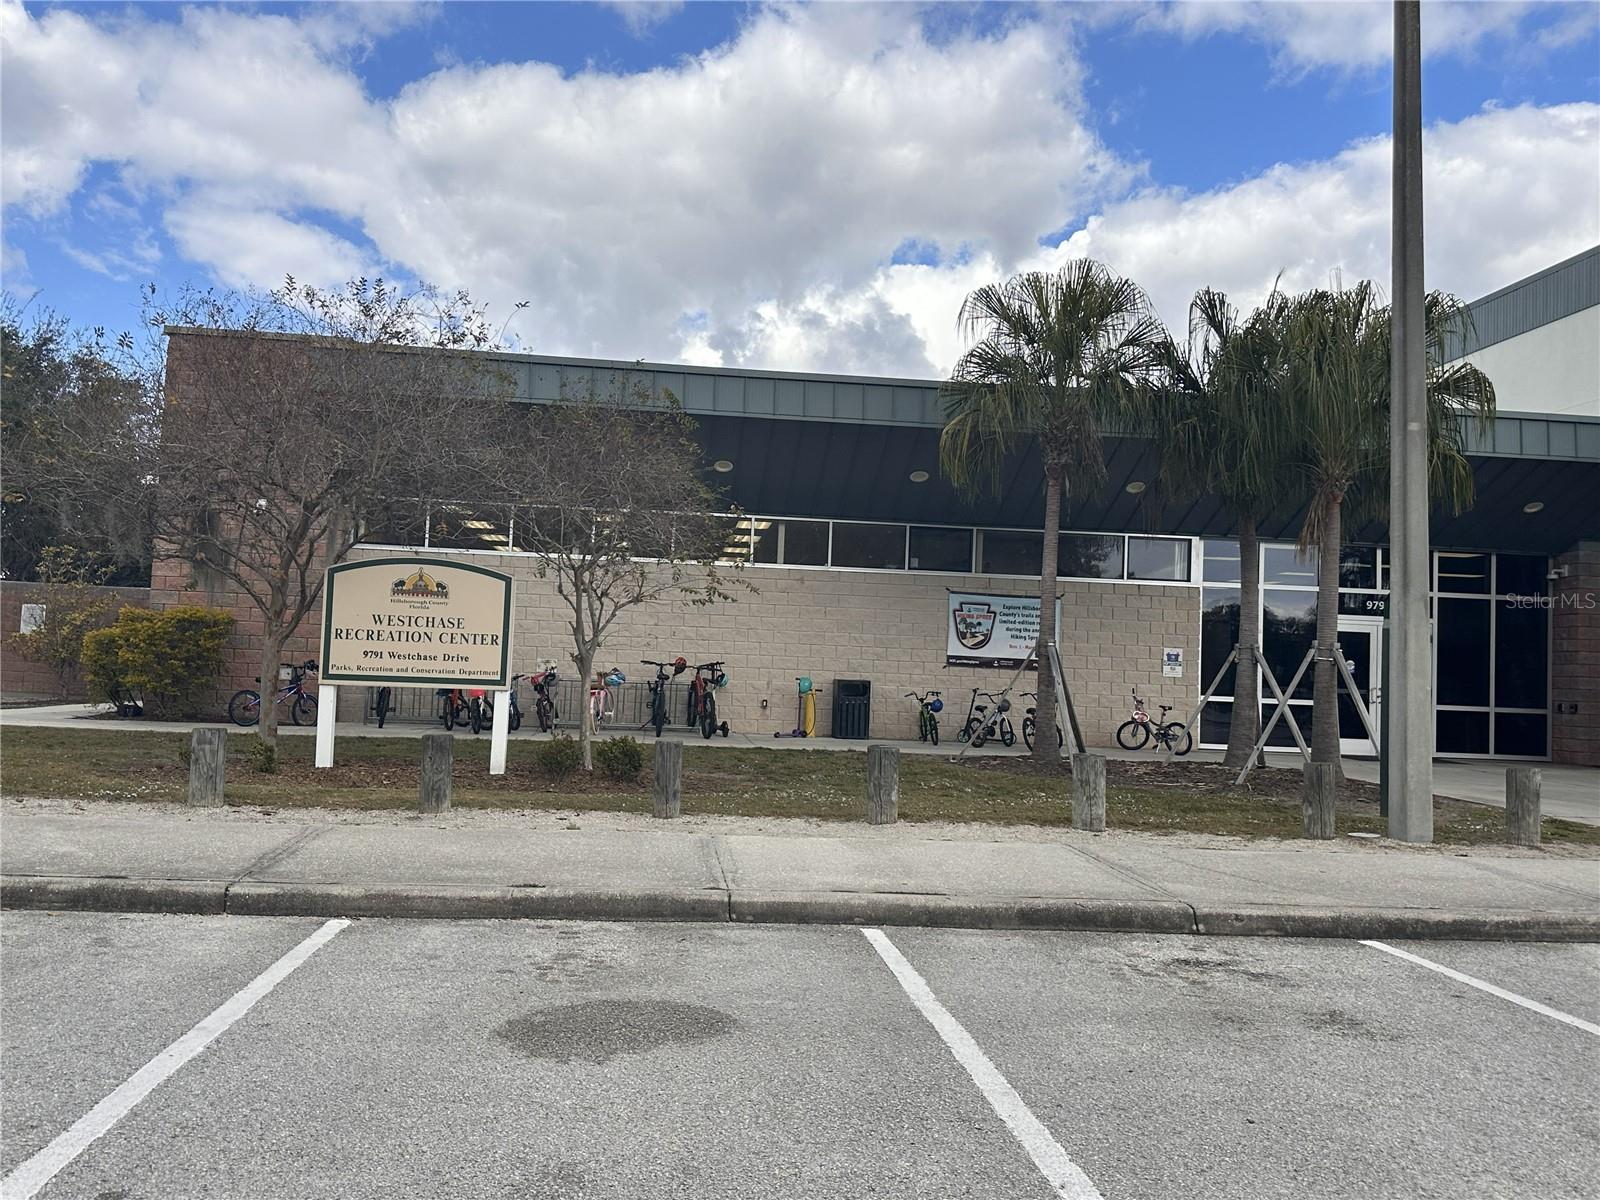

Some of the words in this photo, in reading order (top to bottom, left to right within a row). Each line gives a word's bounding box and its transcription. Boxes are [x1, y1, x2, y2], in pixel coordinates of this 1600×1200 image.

[372, 614, 465, 629] WESTCHASE
[334, 628, 433, 643] RECREATION
[438, 631, 500, 646] CENTER
[362, 650, 383, 659] 9791
[387, 651, 438, 661] Westchase
[442, 653, 470, 663] Drive
[331, 663, 354, 672] Parks,
[356, 664, 394, 673] Recreation
[411, 667, 456, 675] Conservation
[458, 668, 499, 677] Department
